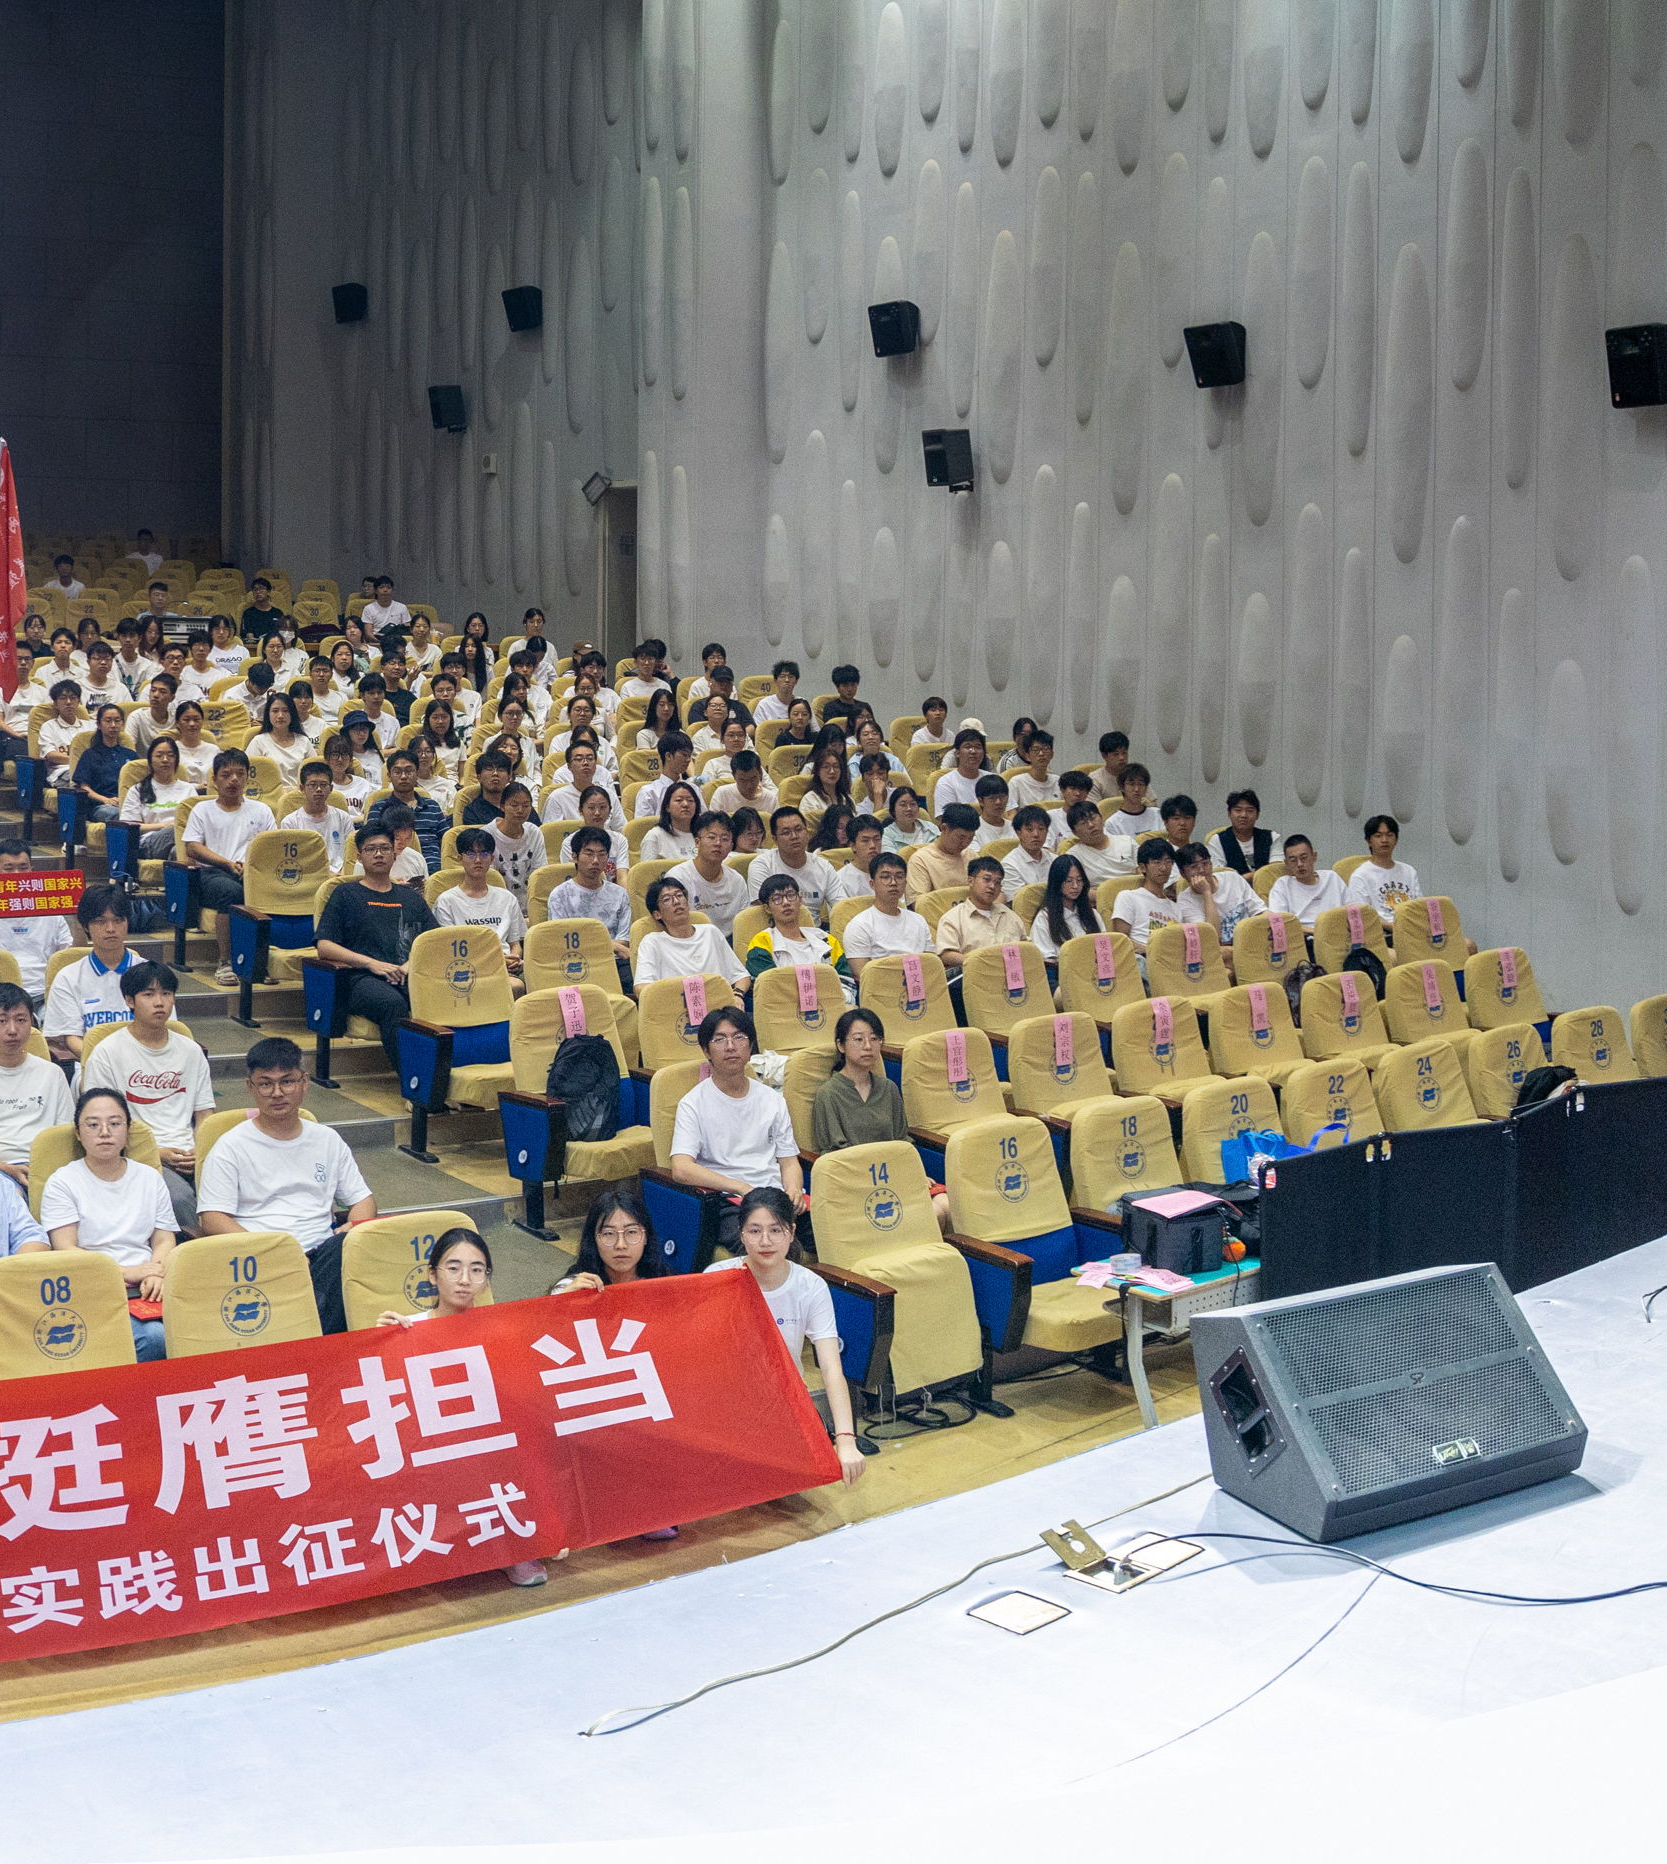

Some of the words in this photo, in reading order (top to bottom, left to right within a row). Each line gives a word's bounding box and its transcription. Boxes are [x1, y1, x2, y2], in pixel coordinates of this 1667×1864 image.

[647, 759, 659, 770] 28
[284, 843, 298, 858] 16
[451, 940, 467, 957] 16
[564, 933, 580, 949] 18
[1590, 1021, 1603, 1037] 28
[1507, 1041, 1521, 1058] 26
[1417, 1057, 1433, 1074] 24
[1328, 1076, 1344, 1093] 22
[1231, 1094, 1248, 1114] 20
[1121, 1116, 1137, 1138] 18
[999, 1137, 1018, 1158] 16
[869, 1163, 889, 1185] 14
[410, 1234, 436, 1263] 12
[228, 1257, 257, 1284] 10
[40, 1277, 71, 1306] 08
